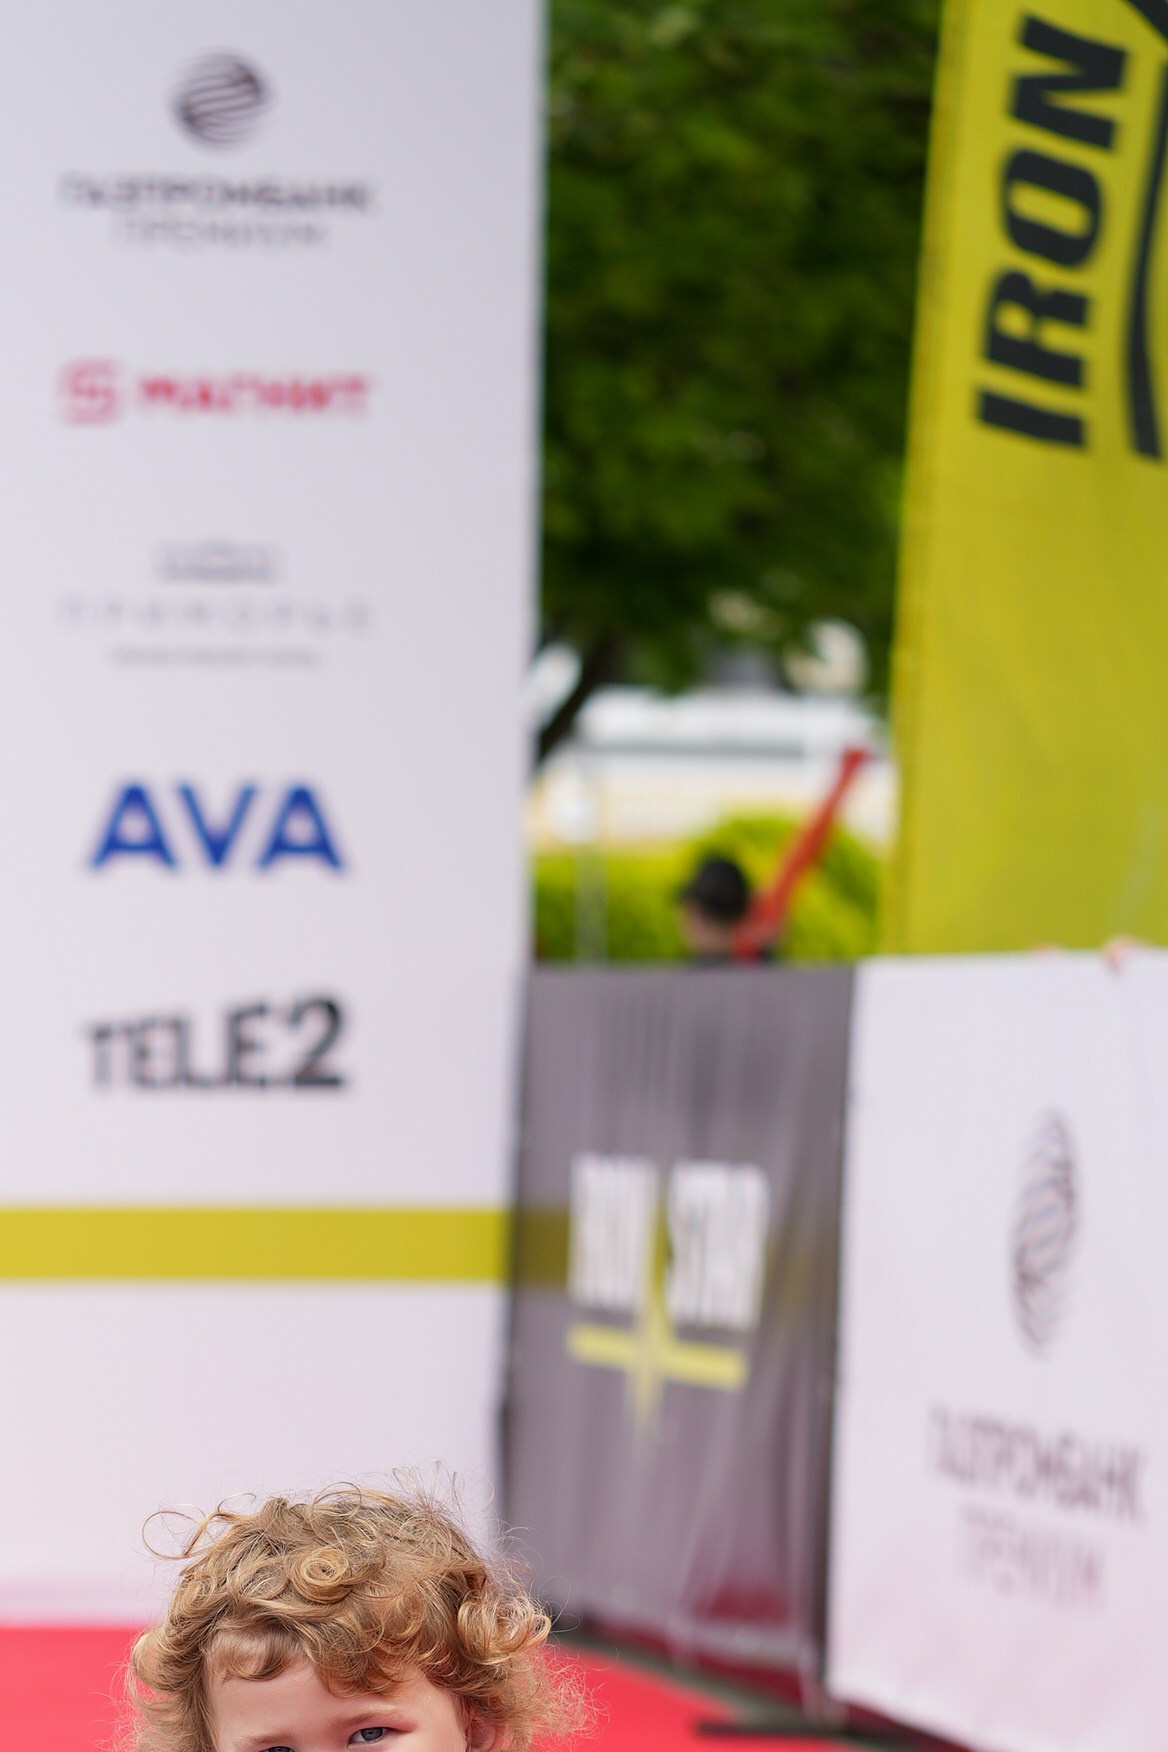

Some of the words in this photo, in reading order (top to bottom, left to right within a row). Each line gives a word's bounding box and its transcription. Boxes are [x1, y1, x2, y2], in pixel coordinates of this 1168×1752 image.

[976, 13, 1130, 450] IRON
[88, 782, 345, 870] AVA
[88, 996, 346, 1090] TELE2
